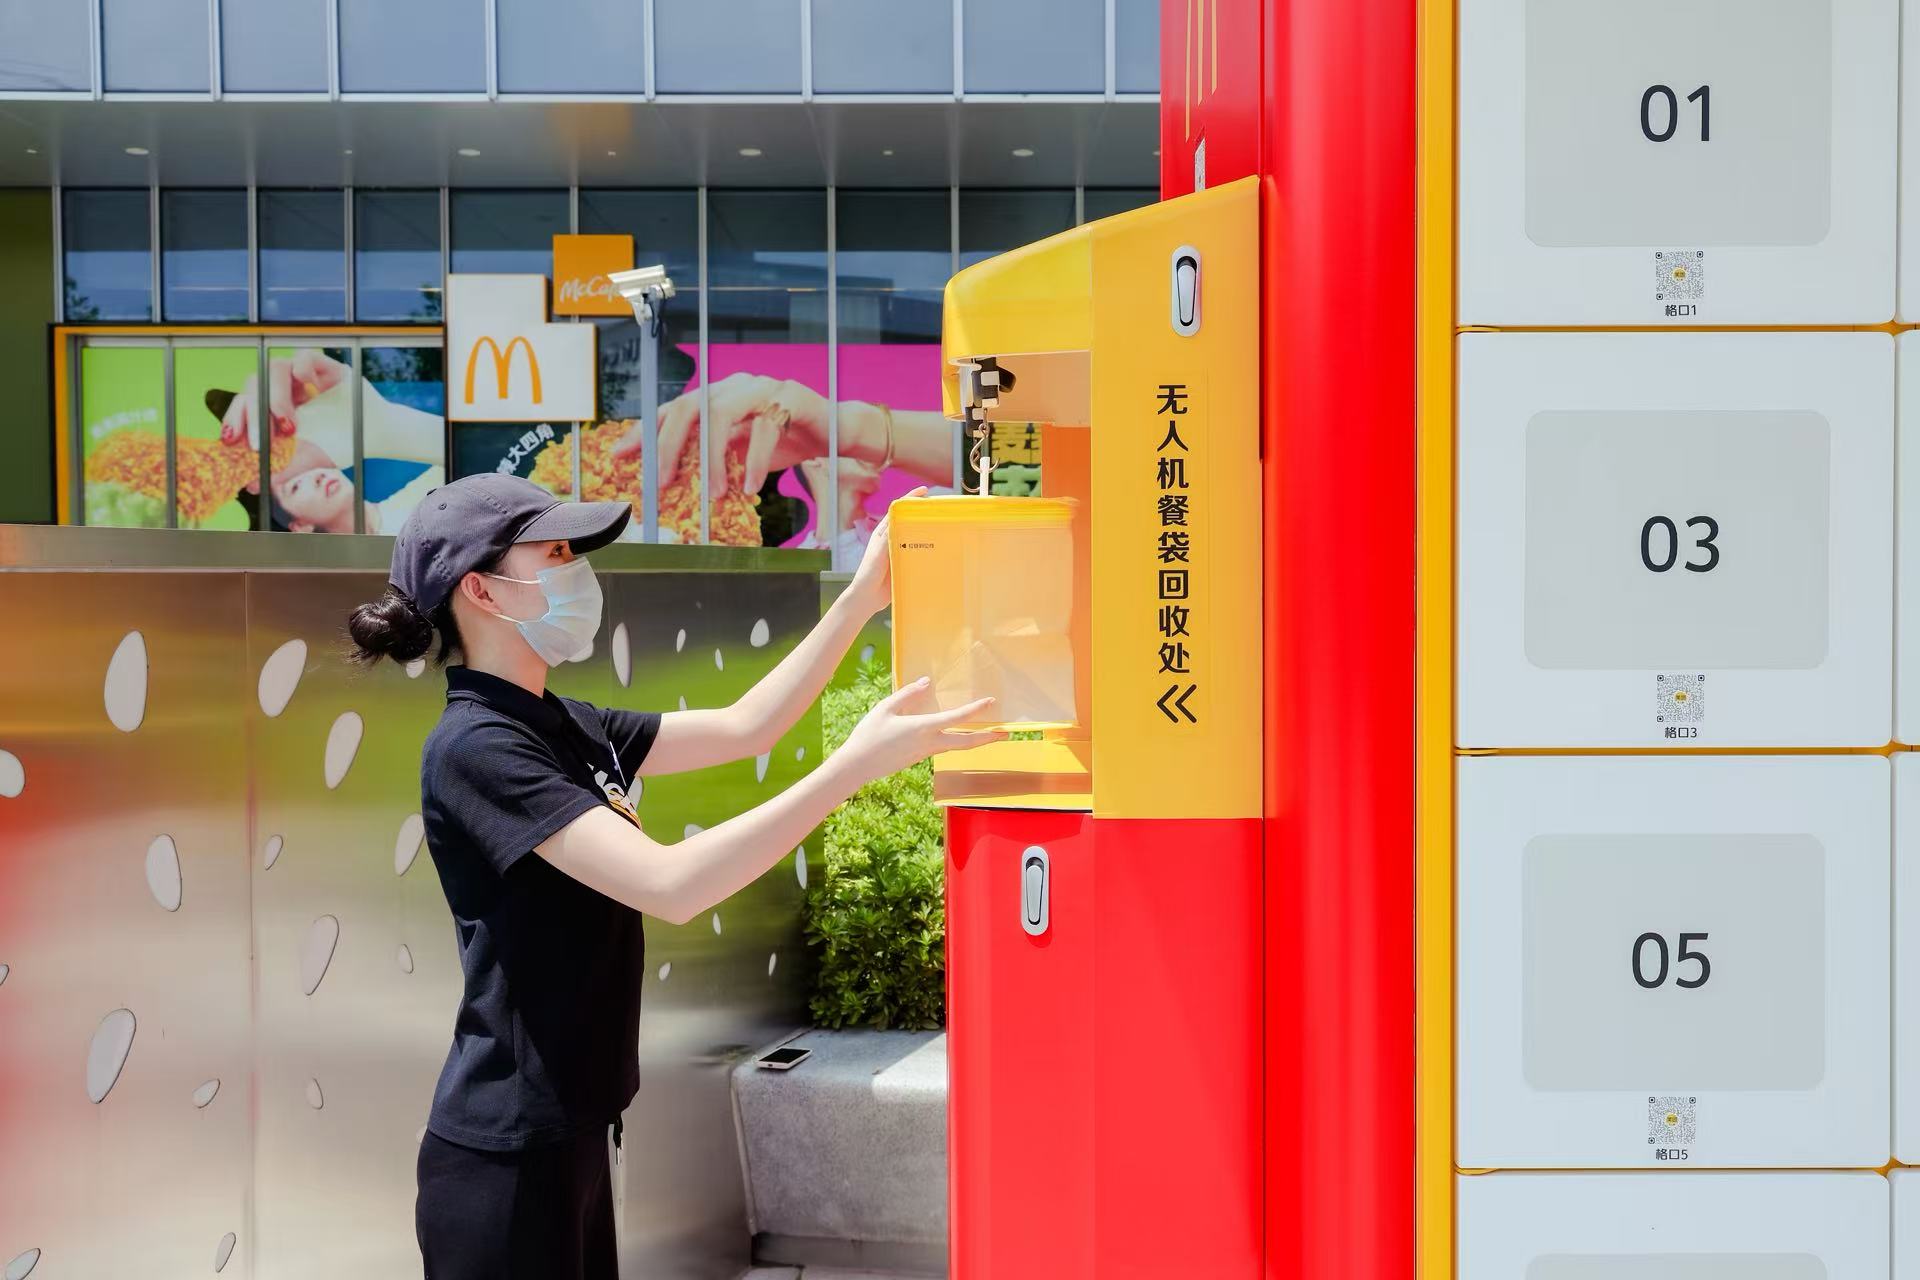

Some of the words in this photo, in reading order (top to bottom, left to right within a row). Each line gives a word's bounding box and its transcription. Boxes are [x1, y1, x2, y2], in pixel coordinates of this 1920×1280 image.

[1639, 83, 1711, 144] 01
[1665, 304, 1697, 317] 格口1
[1156, 384, 1191, 674] 无人机餐袋回收处
[1640, 514, 1721, 574] 03
[1664, 726, 1698, 739] 格口3
[1631, 931, 1712, 990] 05
[1655, 1148, 1689, 1161] 格口5
